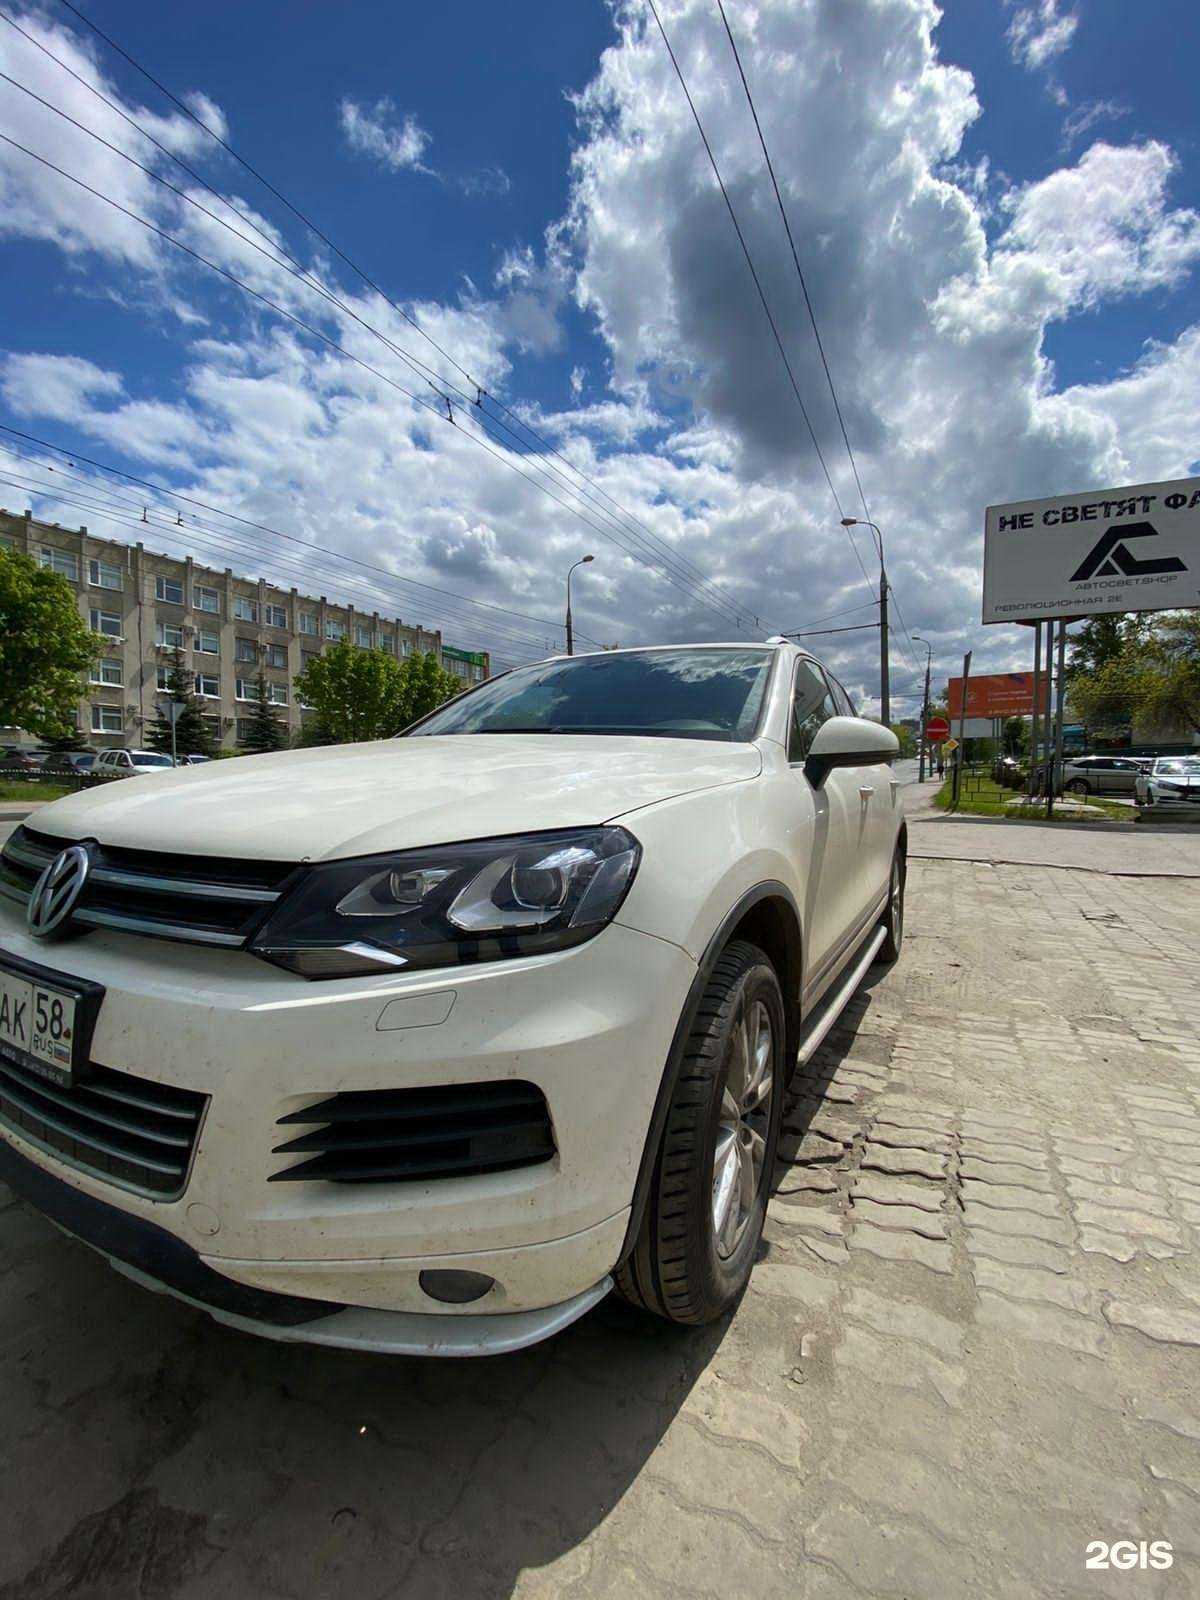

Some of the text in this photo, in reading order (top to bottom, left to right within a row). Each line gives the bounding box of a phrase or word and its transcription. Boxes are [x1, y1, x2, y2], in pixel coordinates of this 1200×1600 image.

[999, 512, 1034, 532] НЕ
[1042, 495, 1157, 526] СВЕТЯТ
[994, 597, 1103, 613] РЕВОЛЮЦИОННАЯ
[36, 992, 63, 1040] 58
[33, 1033, 54, 1057] RUS
